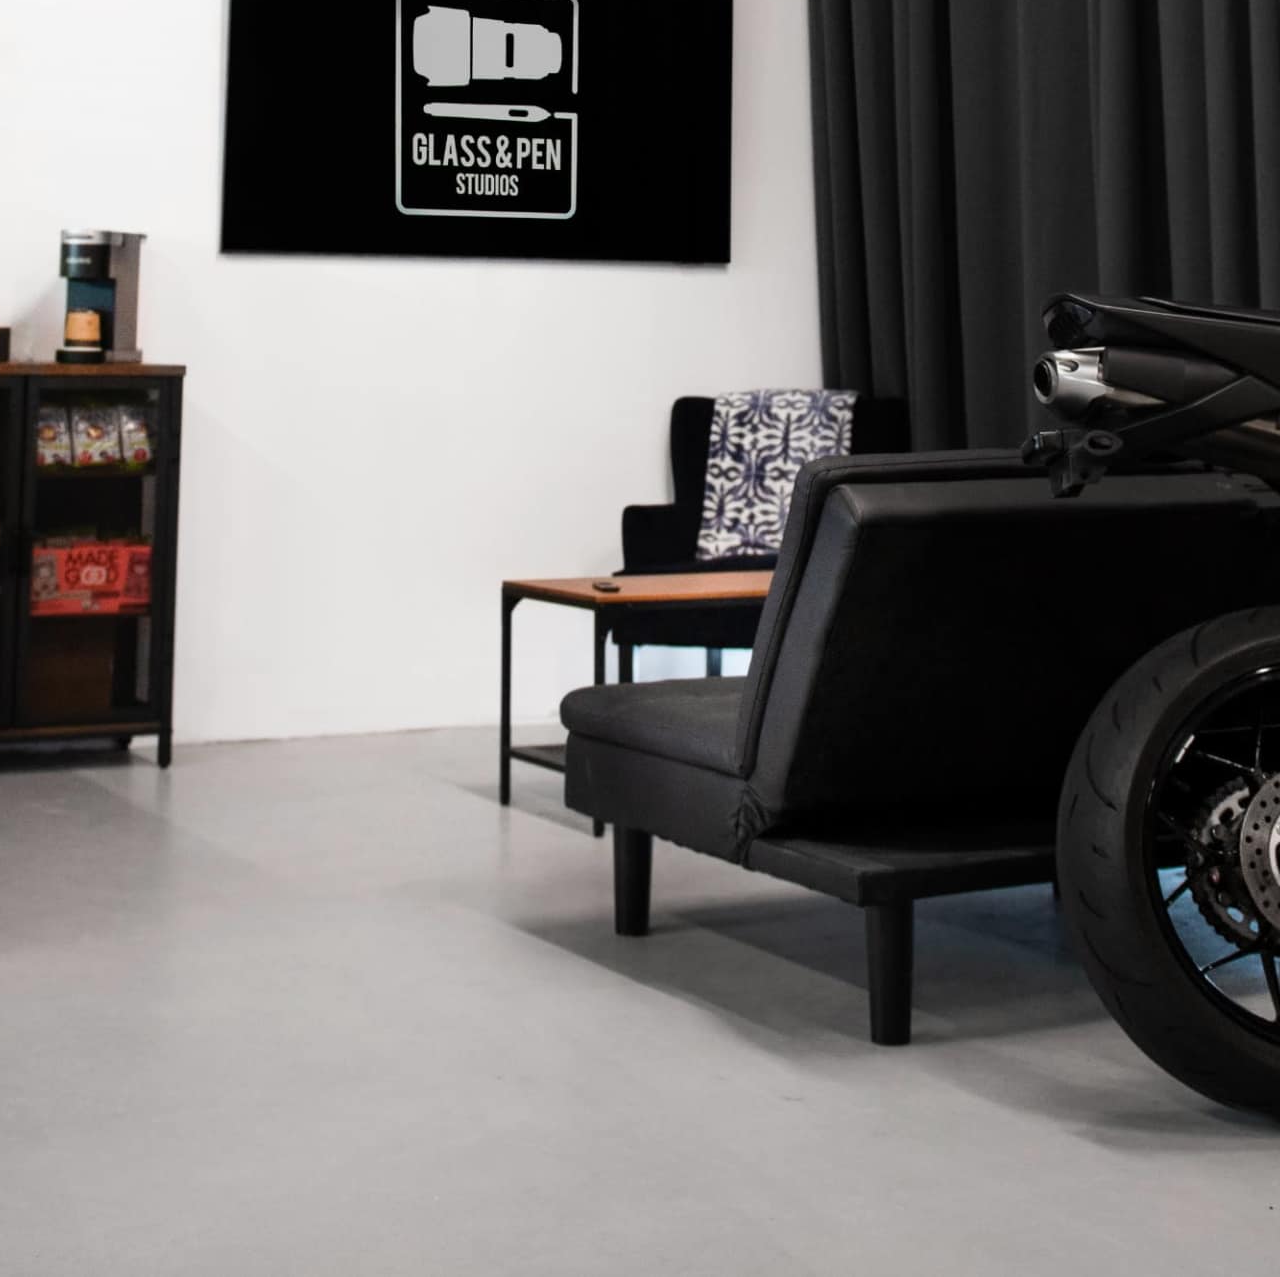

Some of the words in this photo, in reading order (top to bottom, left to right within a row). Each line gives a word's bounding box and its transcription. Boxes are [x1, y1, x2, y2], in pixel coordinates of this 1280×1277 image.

[455, 172, 519, 196] STUDIOS
[66, 549, 119, 567] MADE
[65, 565, 119, 586] GOOD
